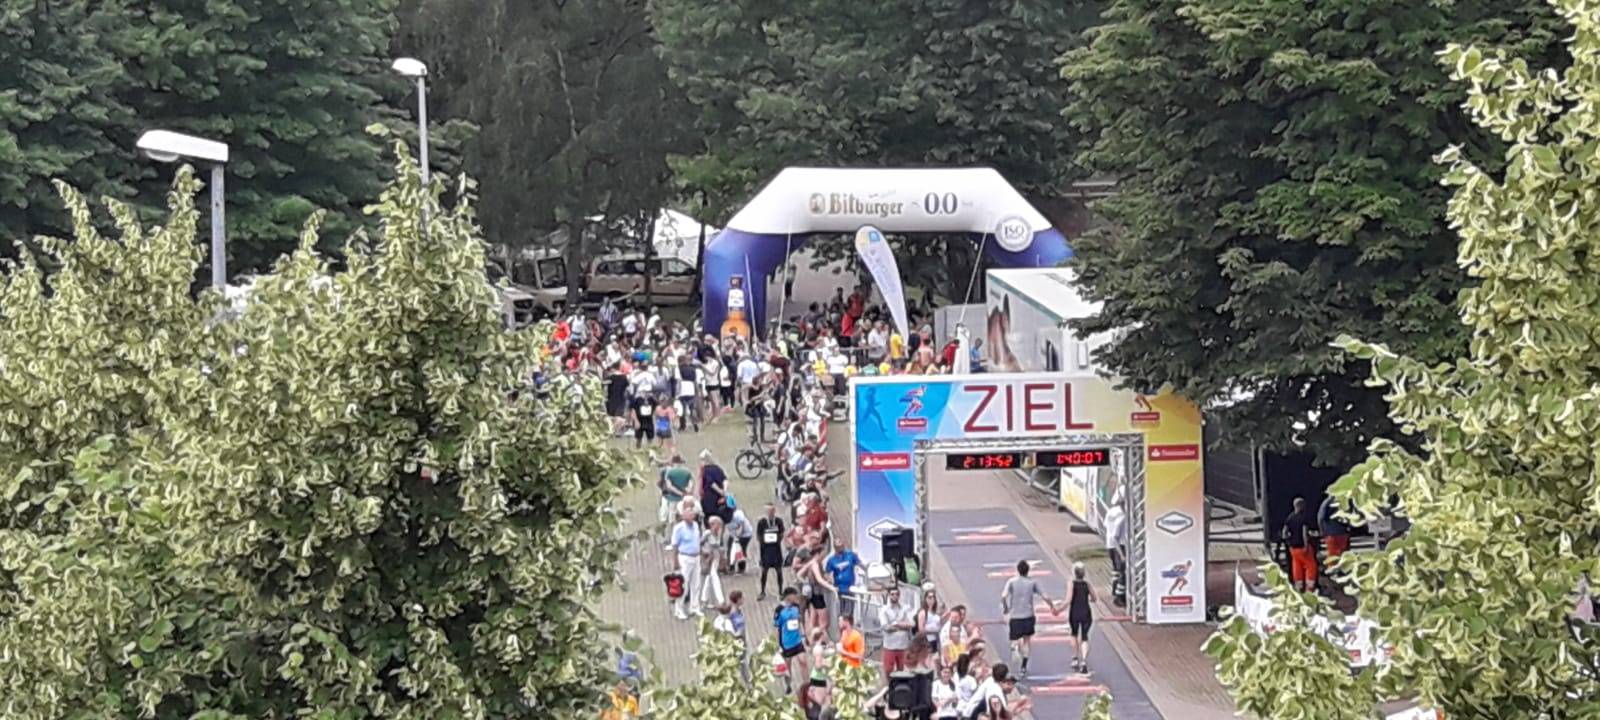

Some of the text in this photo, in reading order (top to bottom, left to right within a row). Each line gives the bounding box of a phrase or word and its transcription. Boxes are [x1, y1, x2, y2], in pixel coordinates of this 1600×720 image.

[828, 191, 958, 218] Bitburger 0.0
[1004, 224, 1026, 240] ISO
[964, 383, 1094, 432] ZIEL
[1056, 451, 1104, 465] 1:40:07
